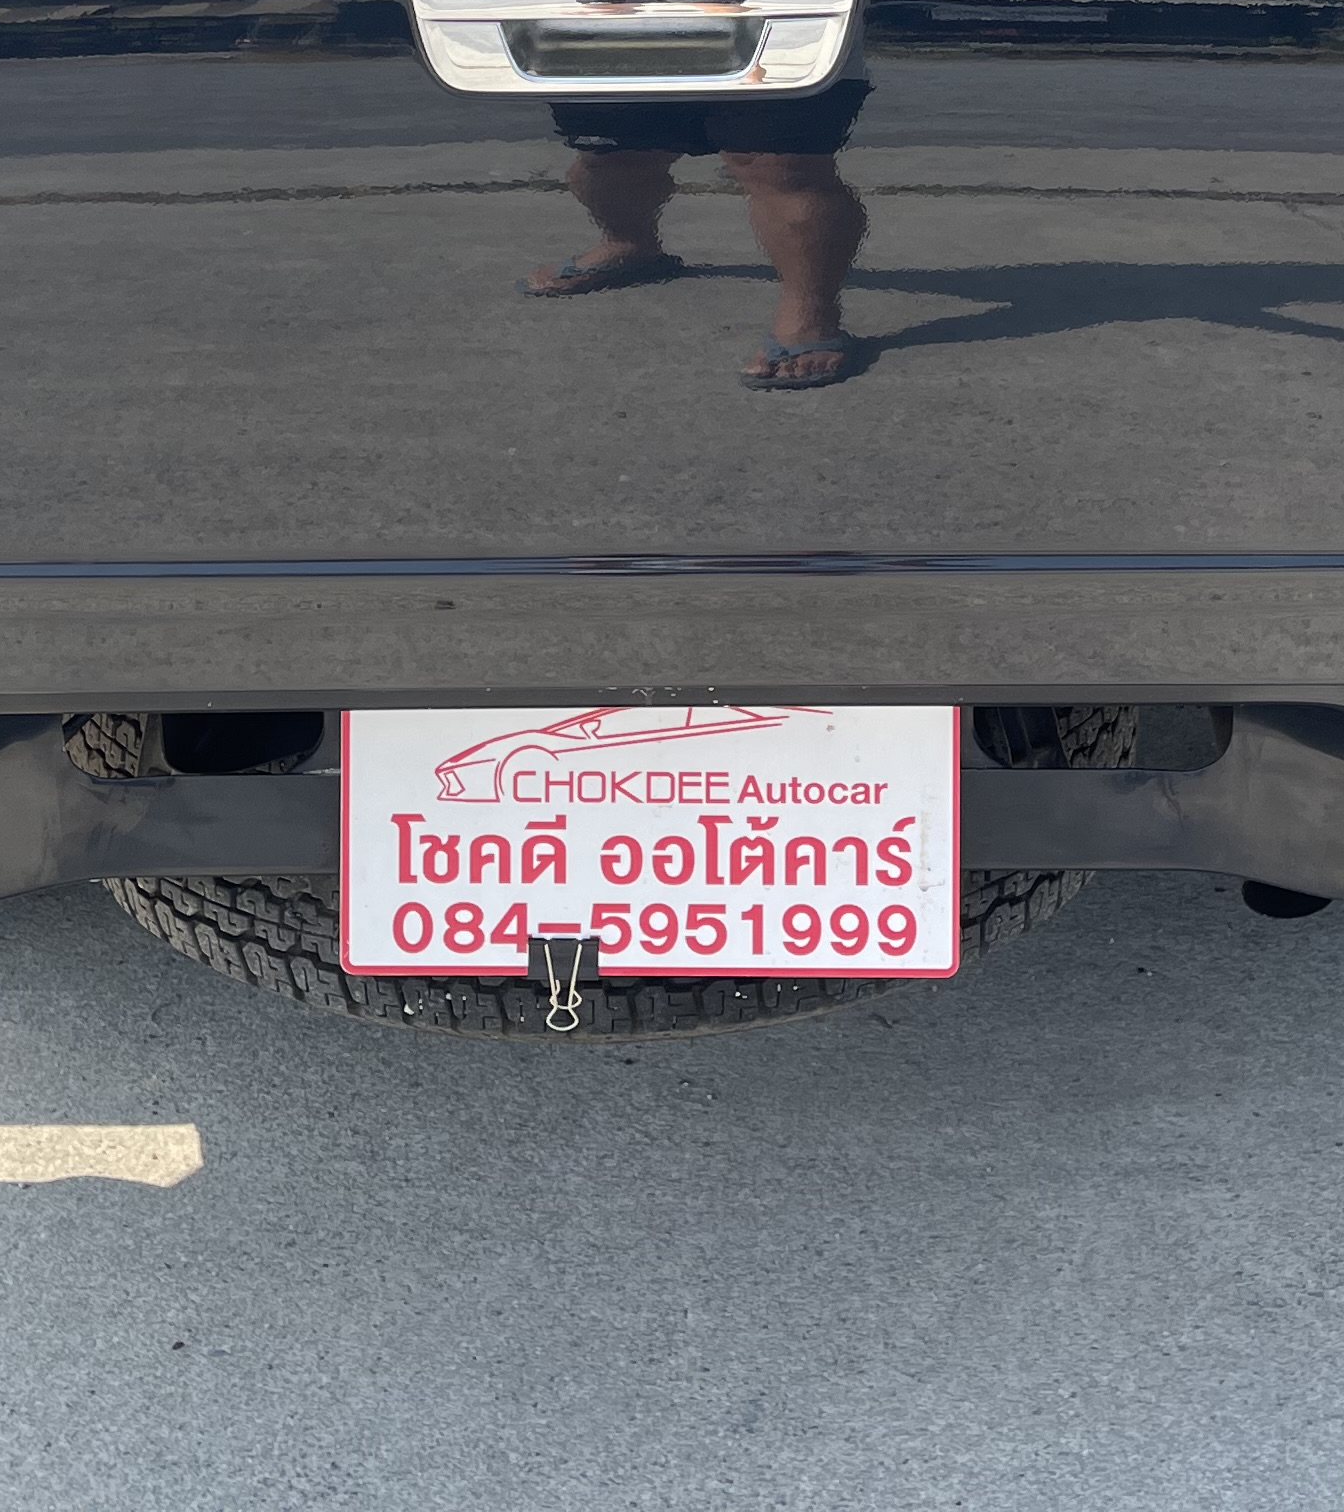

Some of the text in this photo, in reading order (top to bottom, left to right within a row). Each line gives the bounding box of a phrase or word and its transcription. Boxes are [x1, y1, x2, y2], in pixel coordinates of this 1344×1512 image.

[511, 769, 889, 805] CHOKDEE Autocar
[390, 813, 916, 888] โชคดี ออโต้คาร์
[392, 900, 918, 957] 084-5951999
